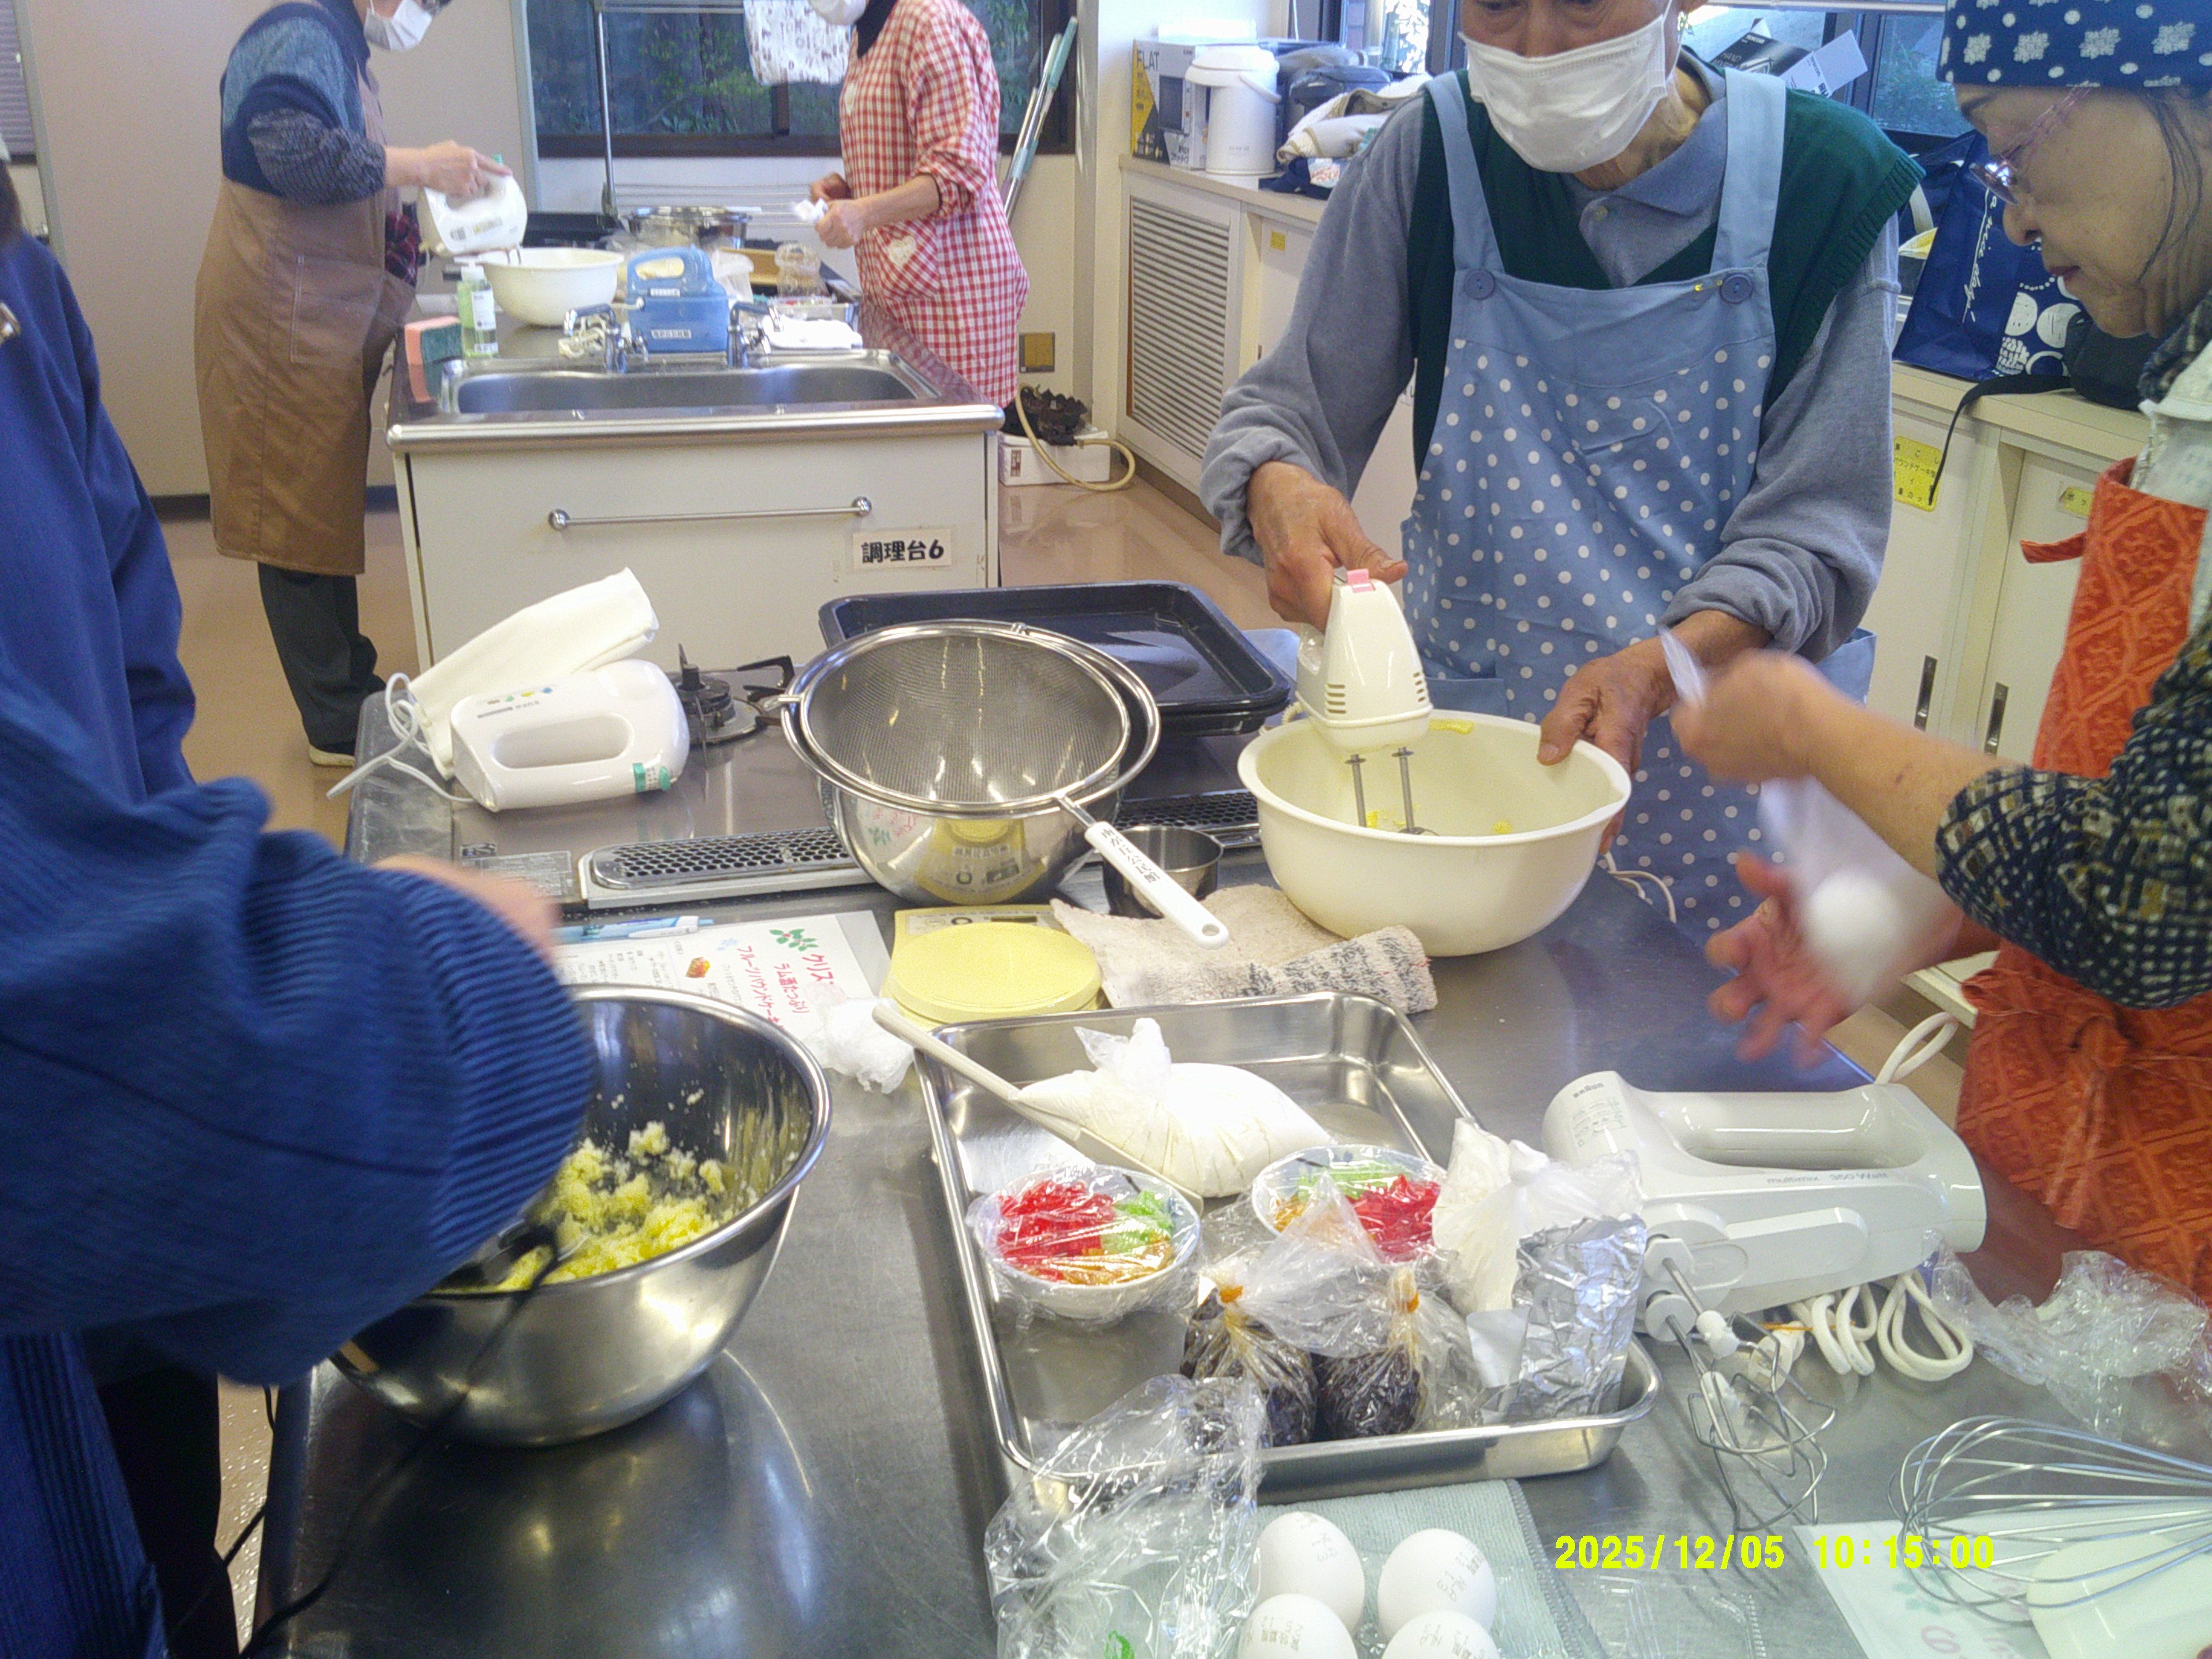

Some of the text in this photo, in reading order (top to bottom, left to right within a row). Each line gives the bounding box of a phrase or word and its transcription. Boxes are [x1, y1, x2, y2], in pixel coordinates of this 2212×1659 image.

[1137, 49, 1160, 71] FLAT
[860, 539, 945, 564] 調理台6
[801, 953, 835, 985] クリス
[736, 945, 784, 1029] フルーツパウンドケーキ
